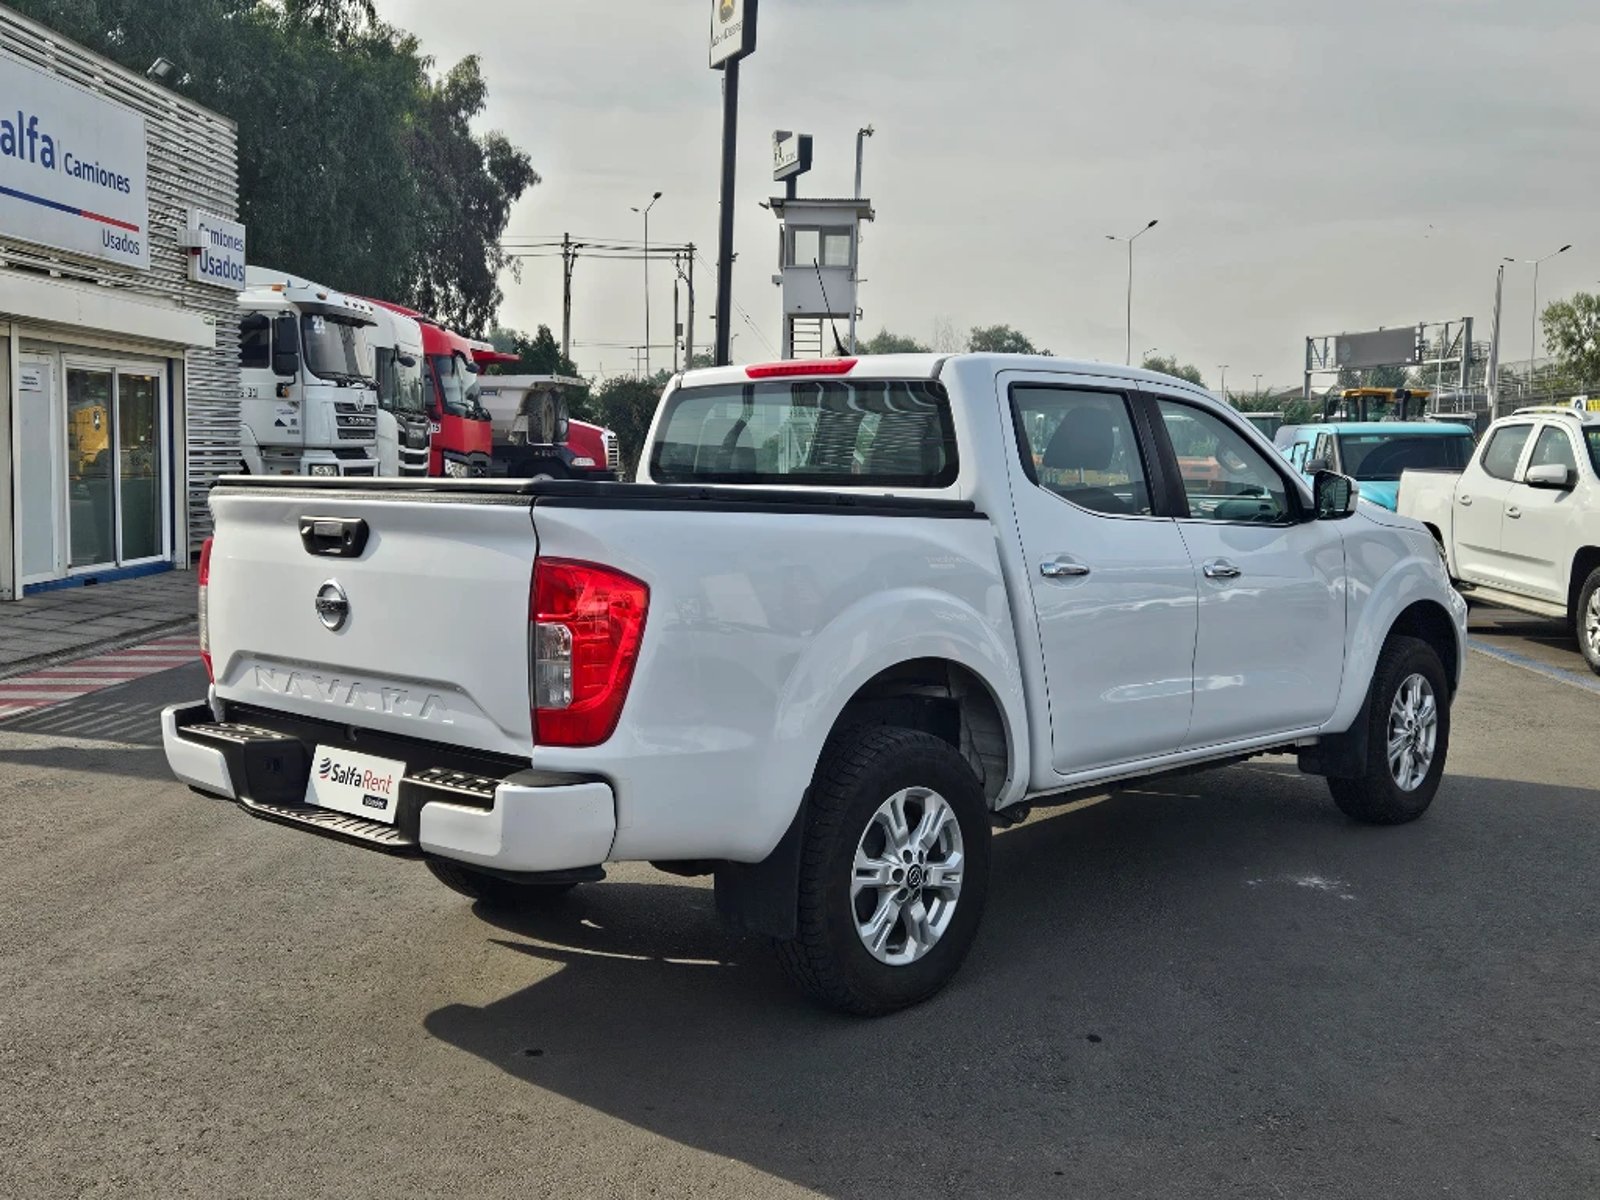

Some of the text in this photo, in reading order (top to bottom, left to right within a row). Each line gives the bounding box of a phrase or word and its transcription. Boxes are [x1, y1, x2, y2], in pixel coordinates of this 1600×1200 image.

[64, 153, 131, 194] Camiones
[102, 228, 140, 256] Usados
[199, 223, 244, 252] miones
[200, 250, 244, 282] Usados
[255, 664, 454, 724] NAVARA
